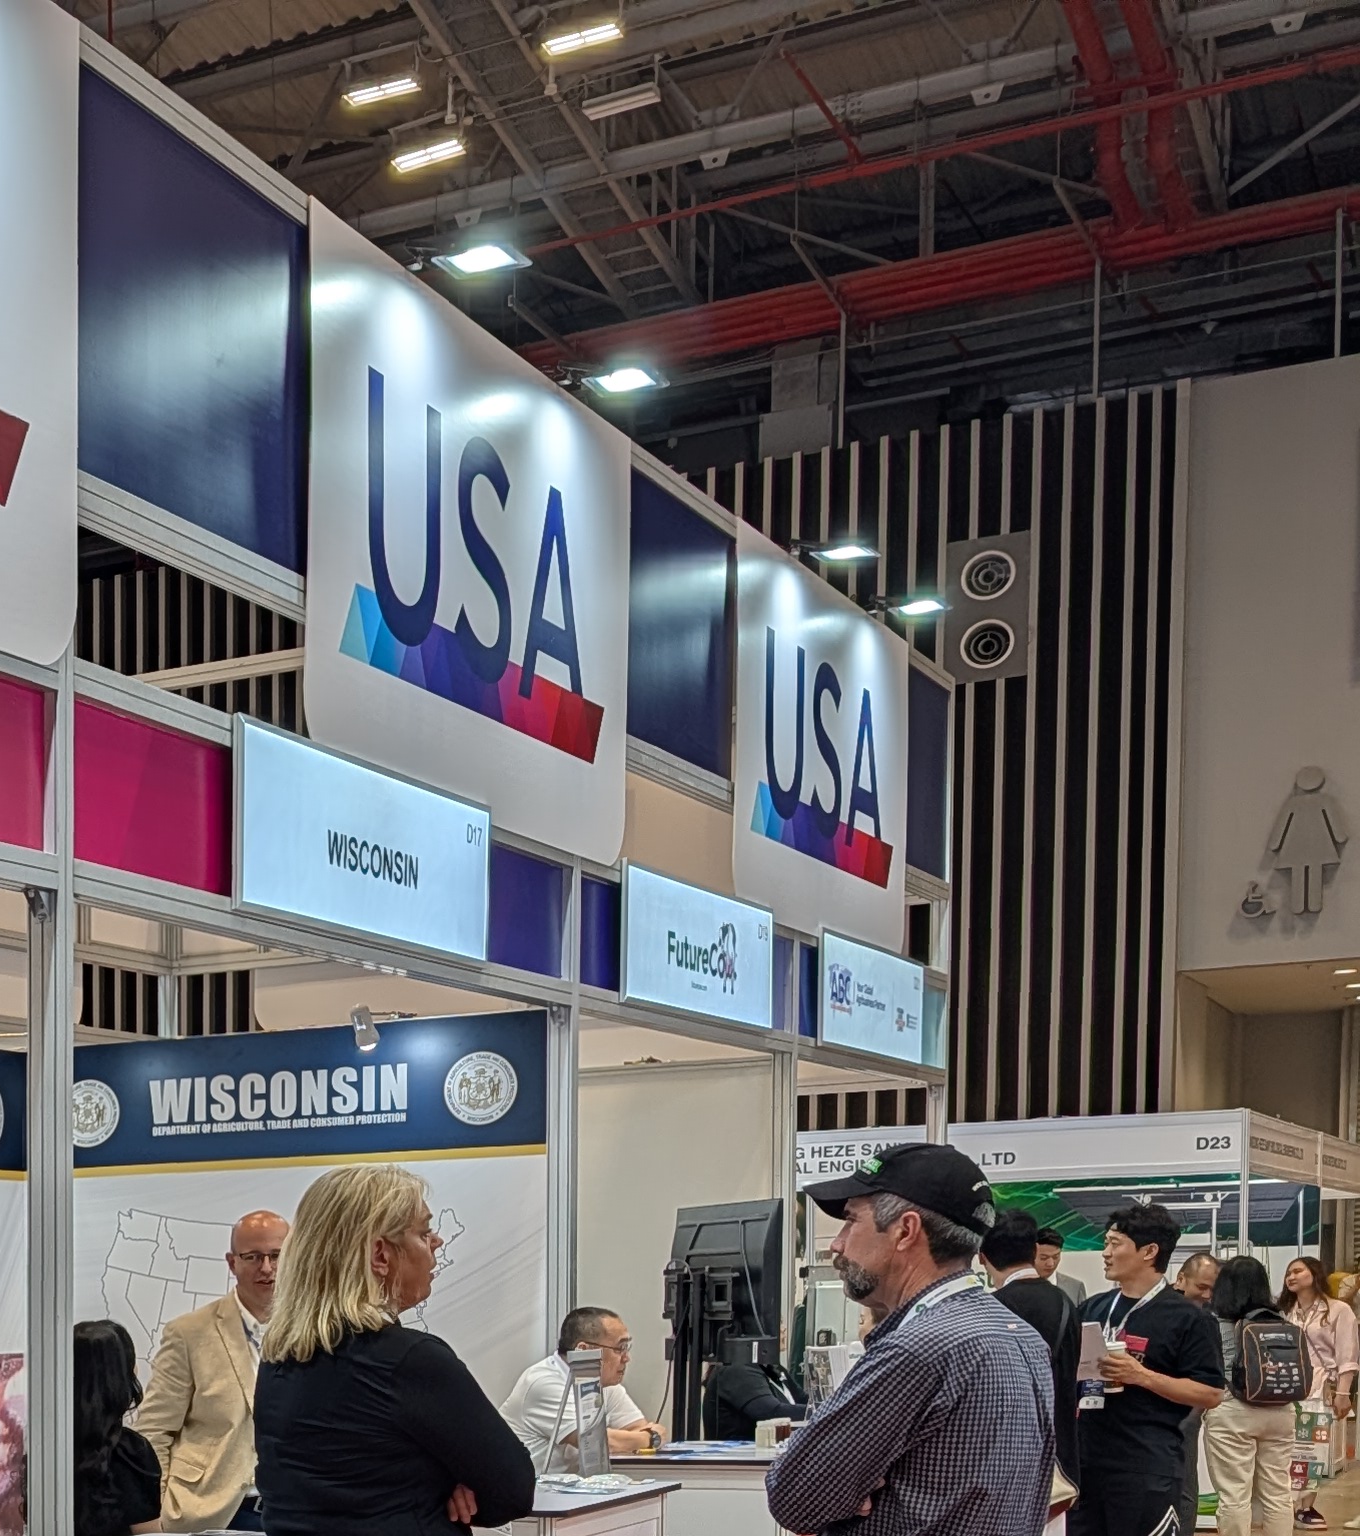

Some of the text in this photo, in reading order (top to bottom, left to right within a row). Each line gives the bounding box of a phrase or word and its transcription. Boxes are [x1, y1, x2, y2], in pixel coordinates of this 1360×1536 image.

[368, 366, 583, 699] USA
[765, 626, 882, 846] USA
[465, 822, 483, 848] D17
[327, 828, 419, 891] WISCONSIN
[830, 970, 851, 1006] ABC
[149, 1063, 408, 1124] WISCONSIN
[152, 1112, 407, 1137] DEPARTMENT OF AGRICULTURE, TRADE AND CONSUMER PROTECTION
[811, 1145, 856, 1158] HEZE
[1196, 1137, 1232, 1150] D23
